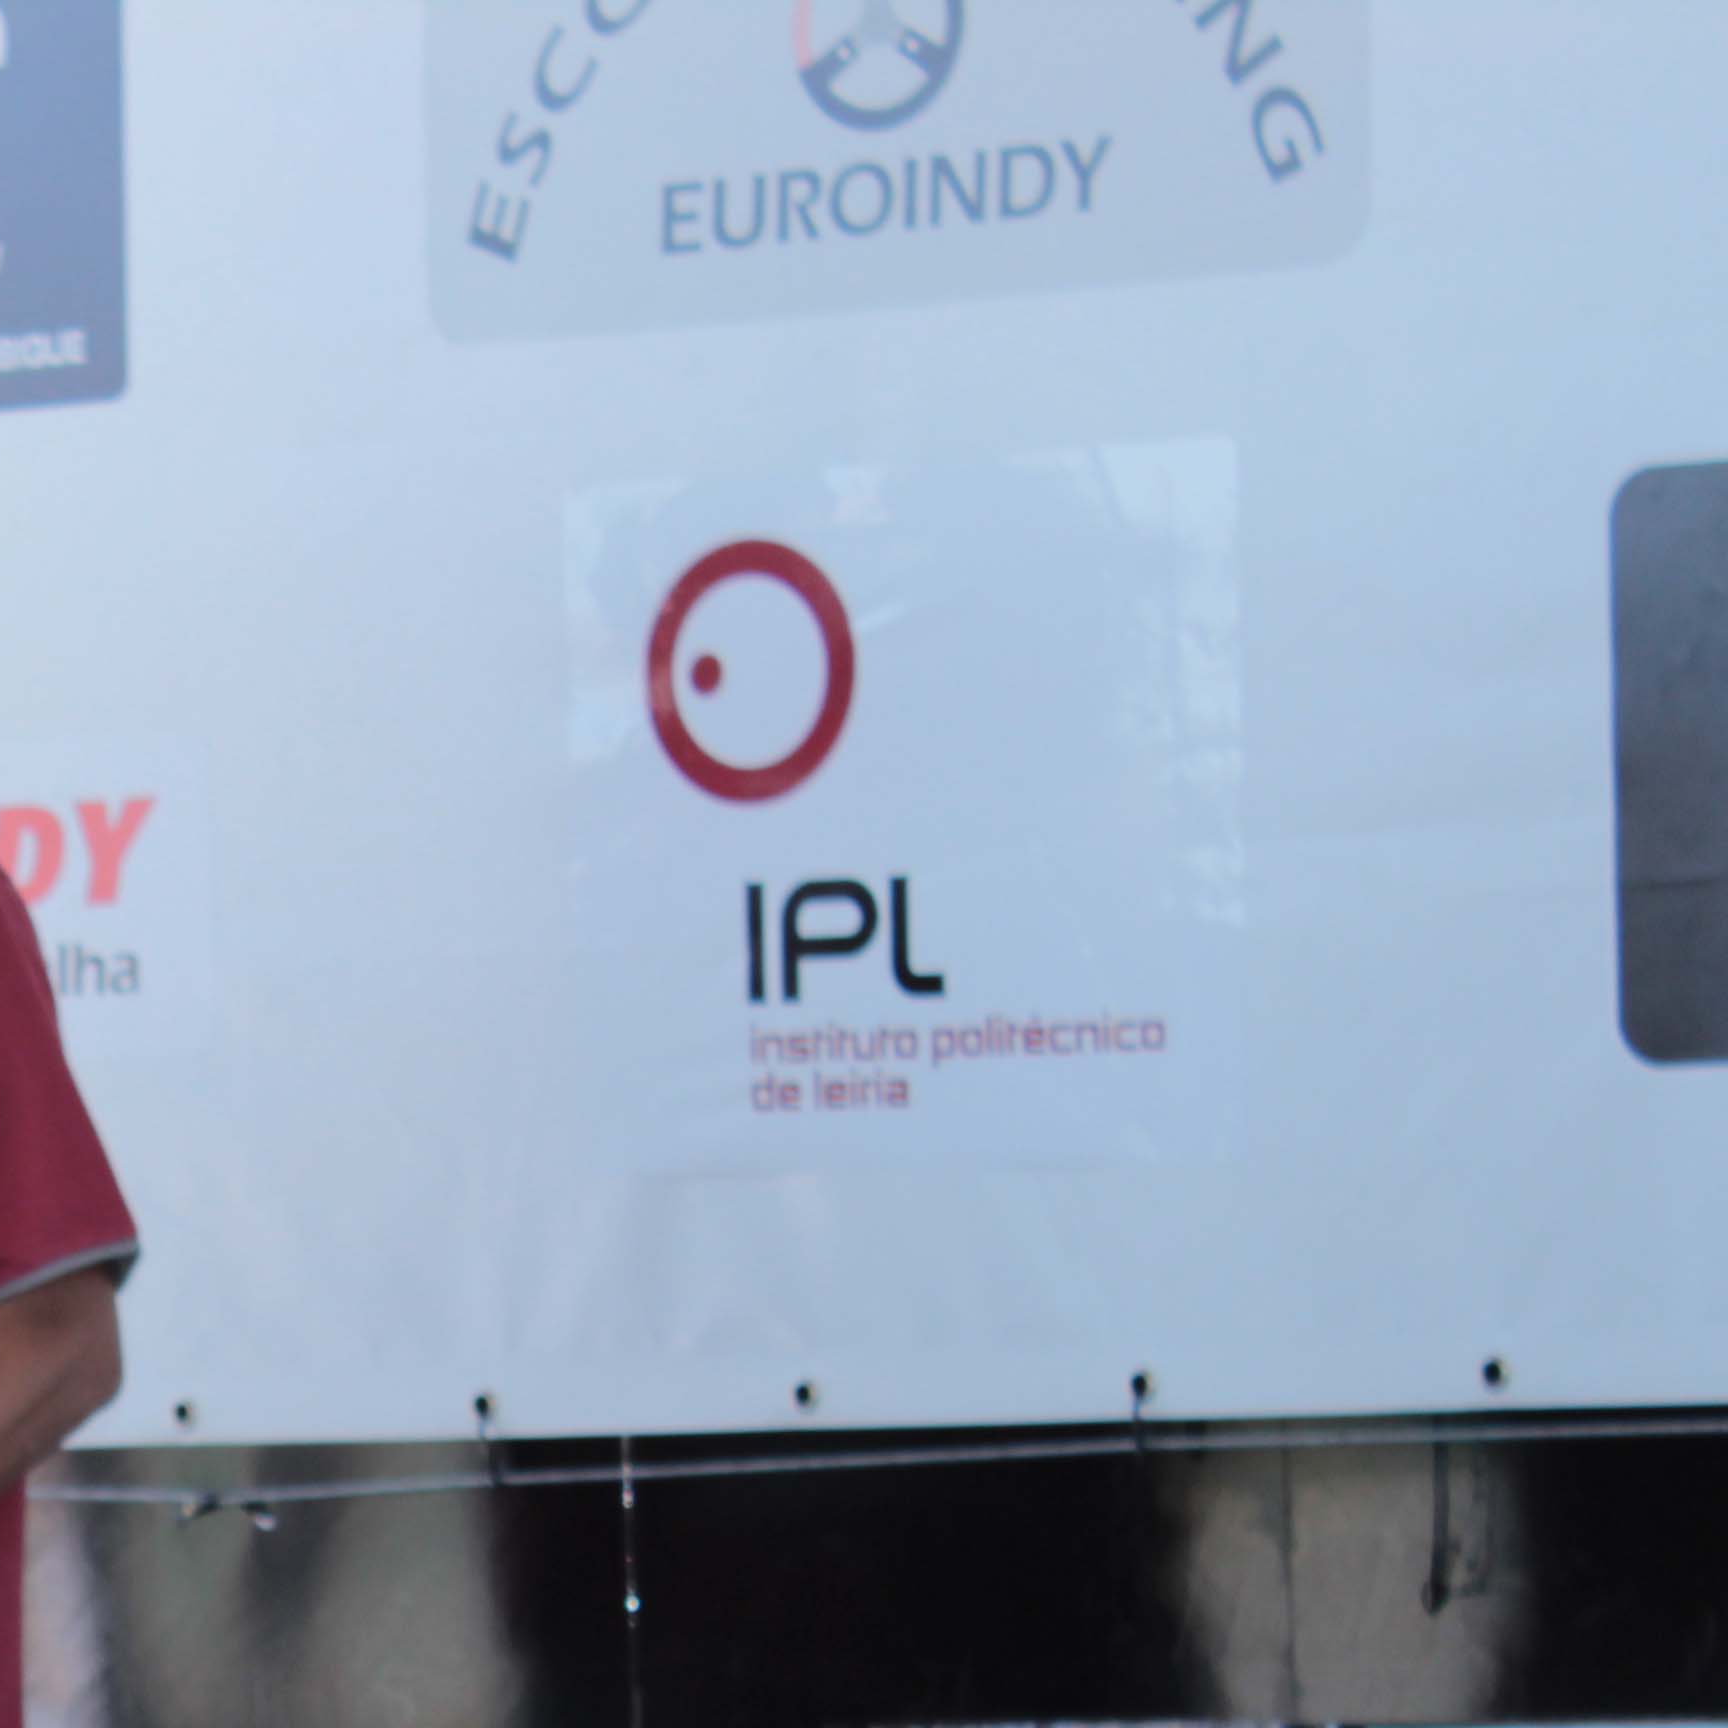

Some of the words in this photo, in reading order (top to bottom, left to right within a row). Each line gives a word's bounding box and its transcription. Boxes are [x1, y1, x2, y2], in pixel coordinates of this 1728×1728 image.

[1178, 0, 1325, 183] NG
[658, 136, 1112, 255] EUROINDY
[56, 940, 142, 998] lha
[746, 874, 946, 1006] IPL
[749, 1023, 919, 1064] instituto
[929, 1014, 1167, 1068] politécnico
[750, 1074, 802, 1112] de
[811, 1068, 911, 1112] leiria
